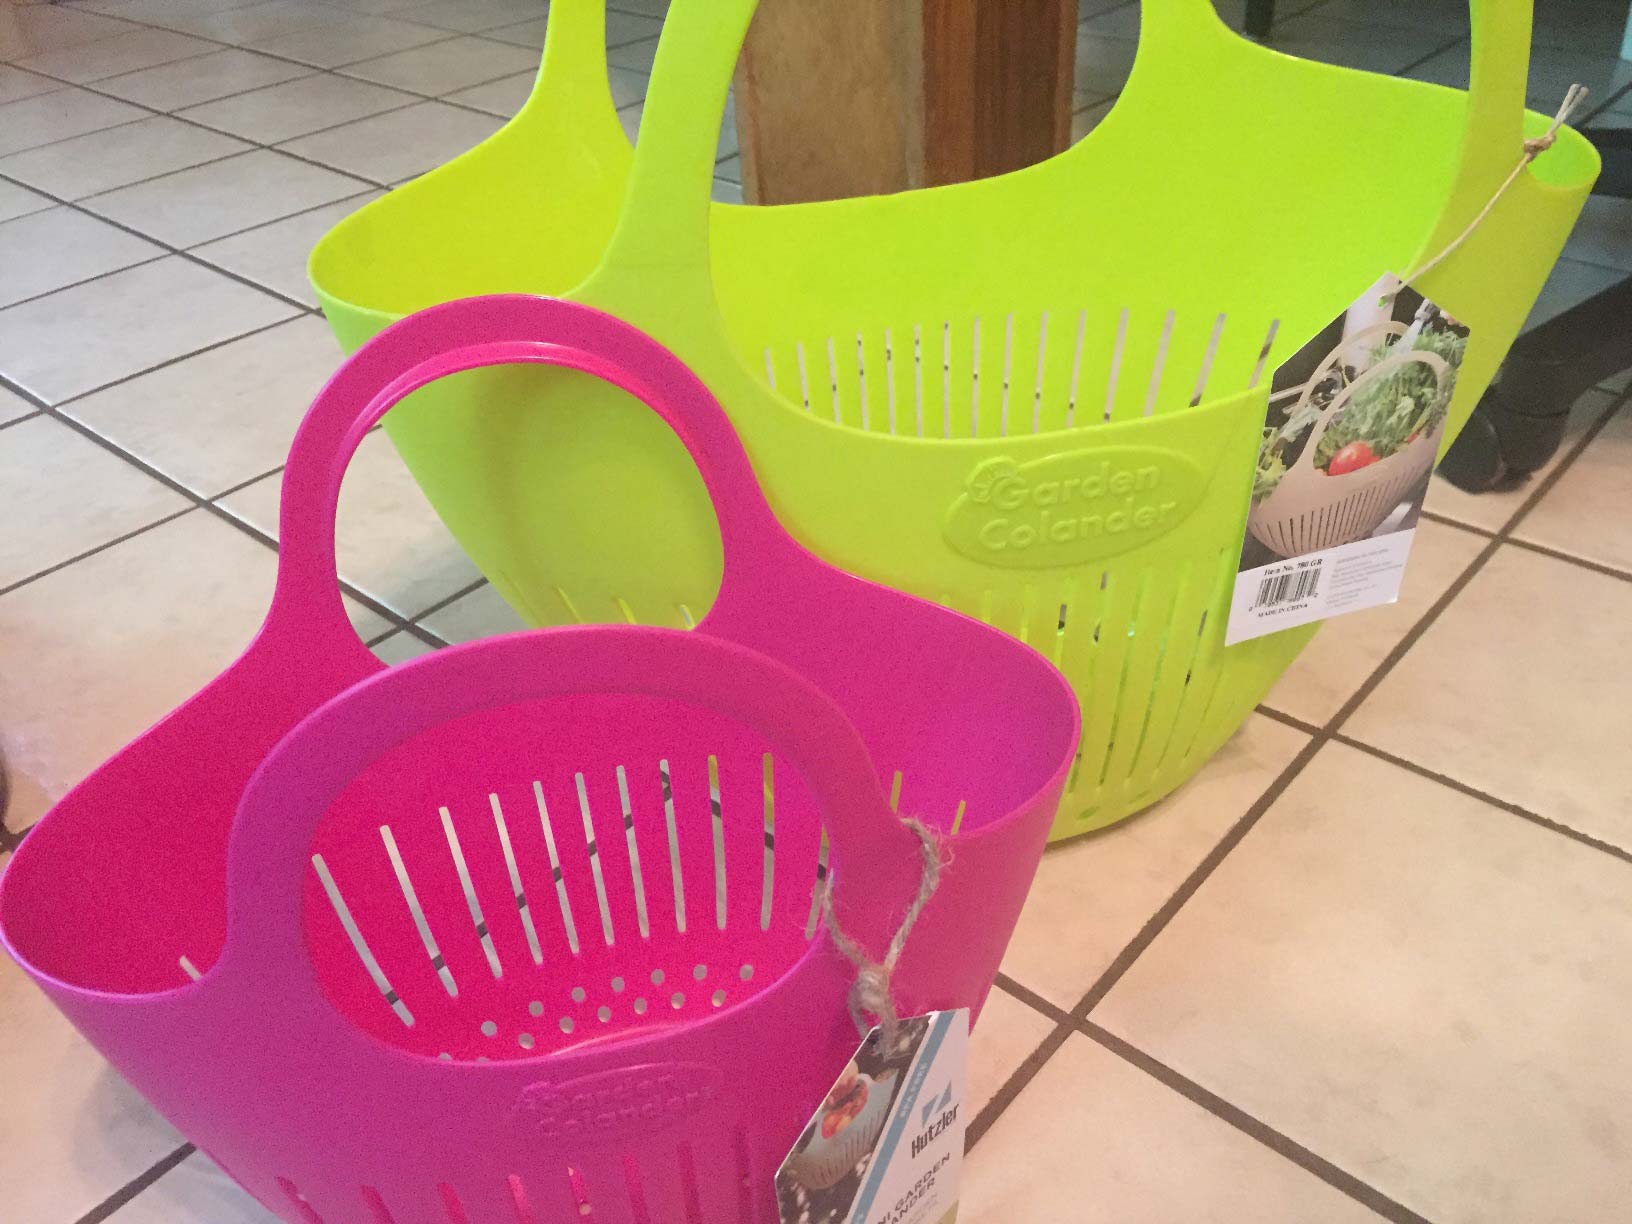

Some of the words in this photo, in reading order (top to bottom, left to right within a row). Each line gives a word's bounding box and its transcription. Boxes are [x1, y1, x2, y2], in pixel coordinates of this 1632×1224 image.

[991, 461, 1160, 510] Garden
[977, 496, 1177, 550] Colander
[1286, 603, 1308, 612] CHINA
[911, 1103, 960, 1159] Hutzler
[895, 1151, 950, 1211] GARDEN
